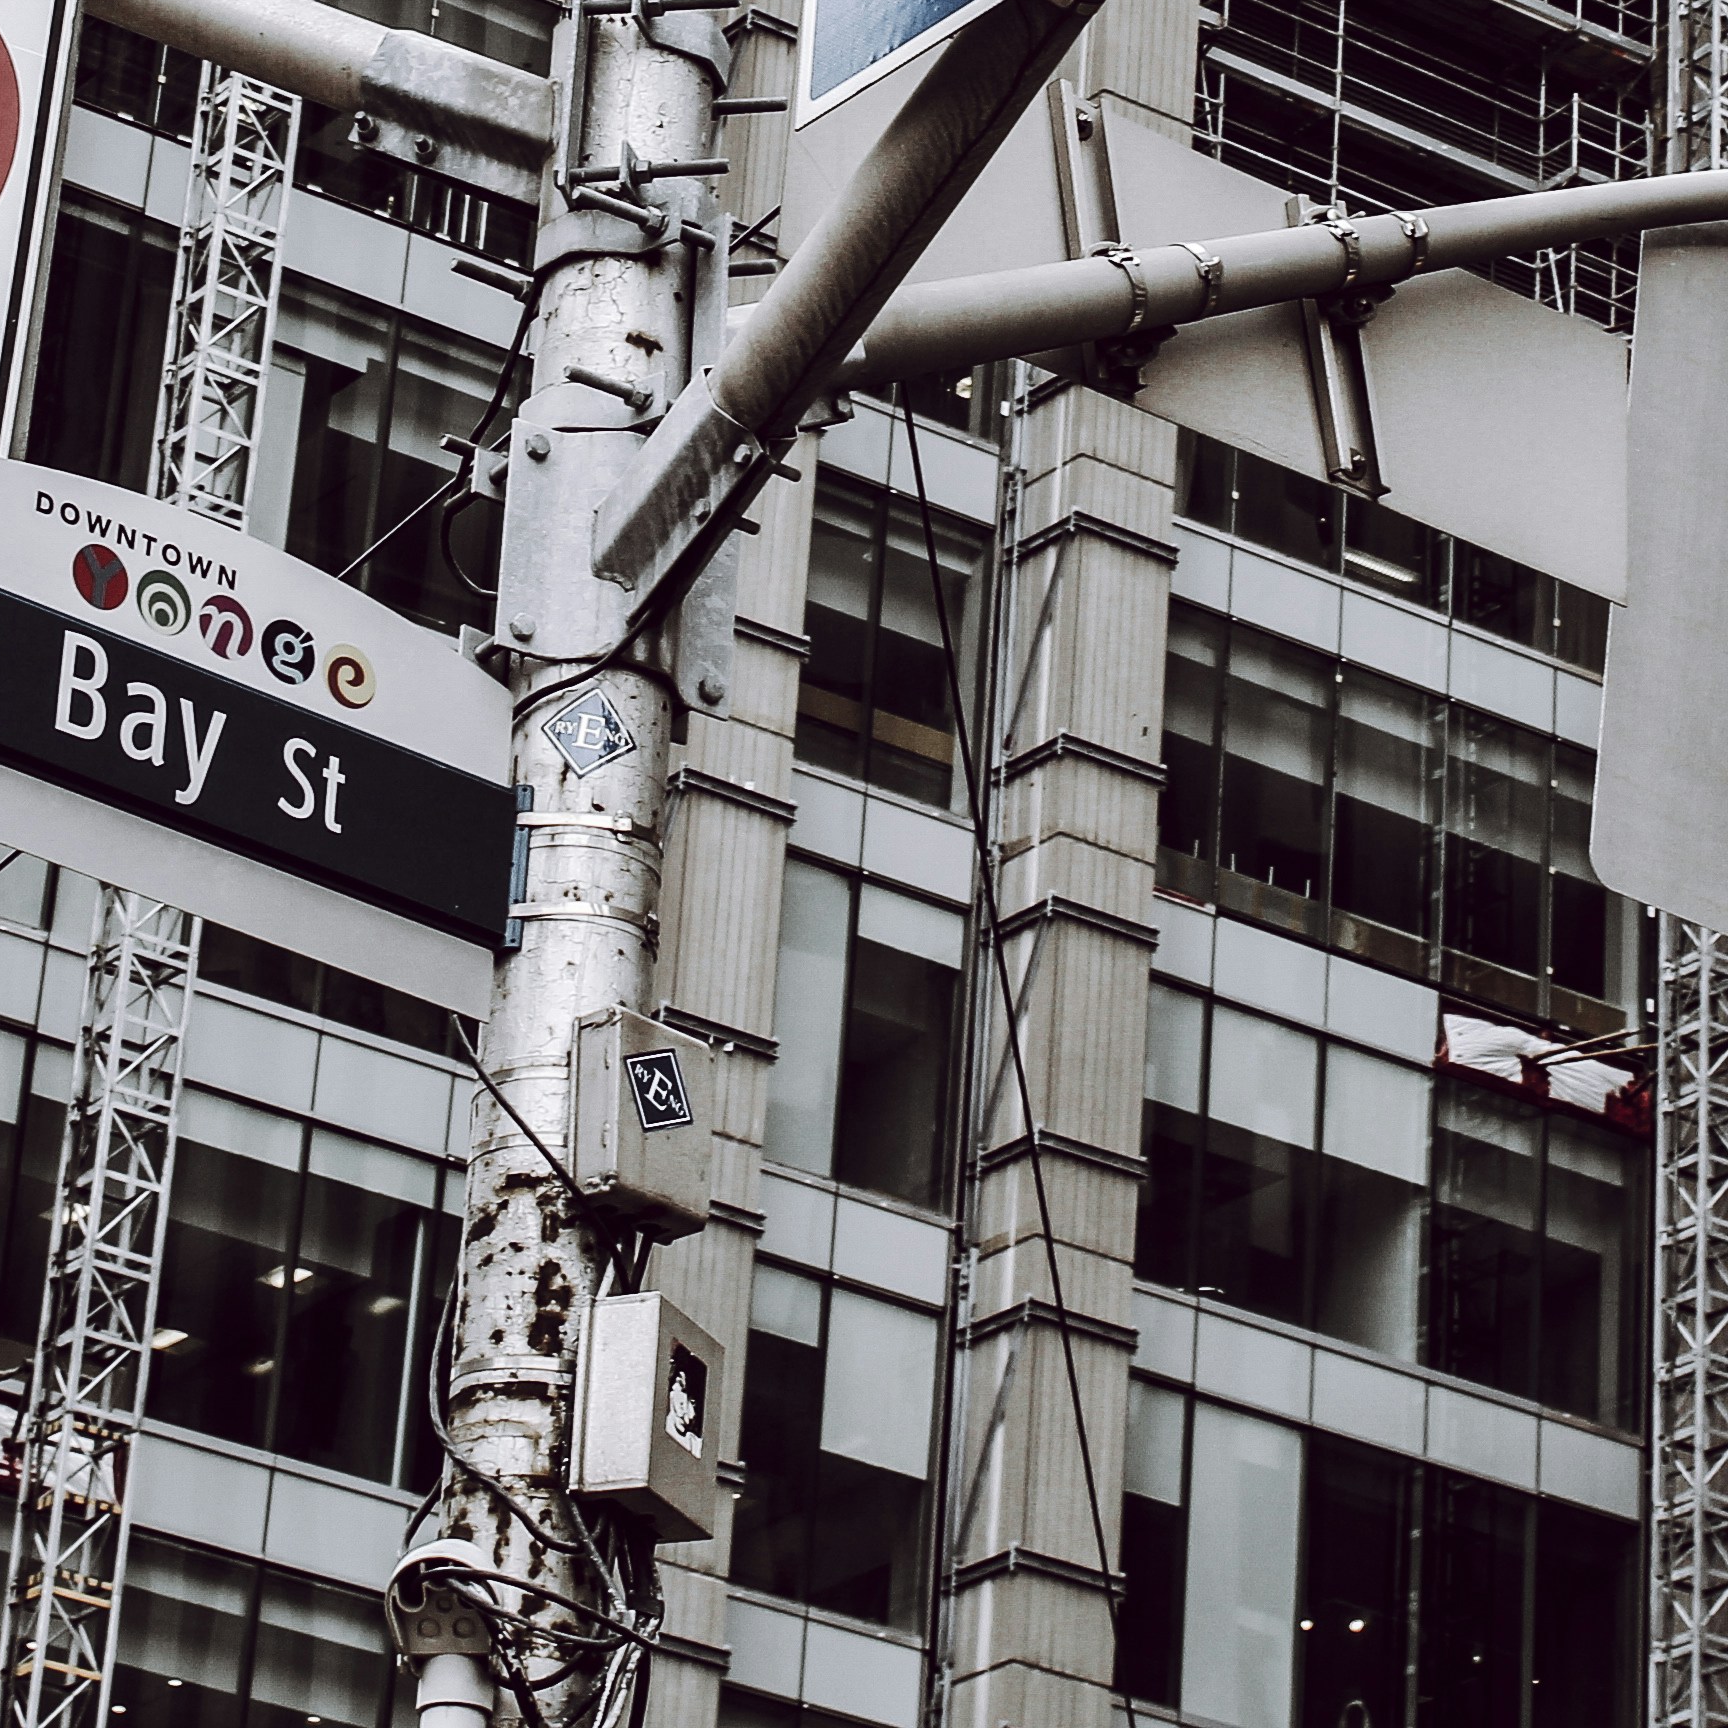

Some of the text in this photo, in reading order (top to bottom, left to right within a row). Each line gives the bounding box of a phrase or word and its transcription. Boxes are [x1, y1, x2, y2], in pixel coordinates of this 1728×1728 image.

[35, 490, 238, 591] DOWNTOWN
[54, 629, 347, 834] Bay St
